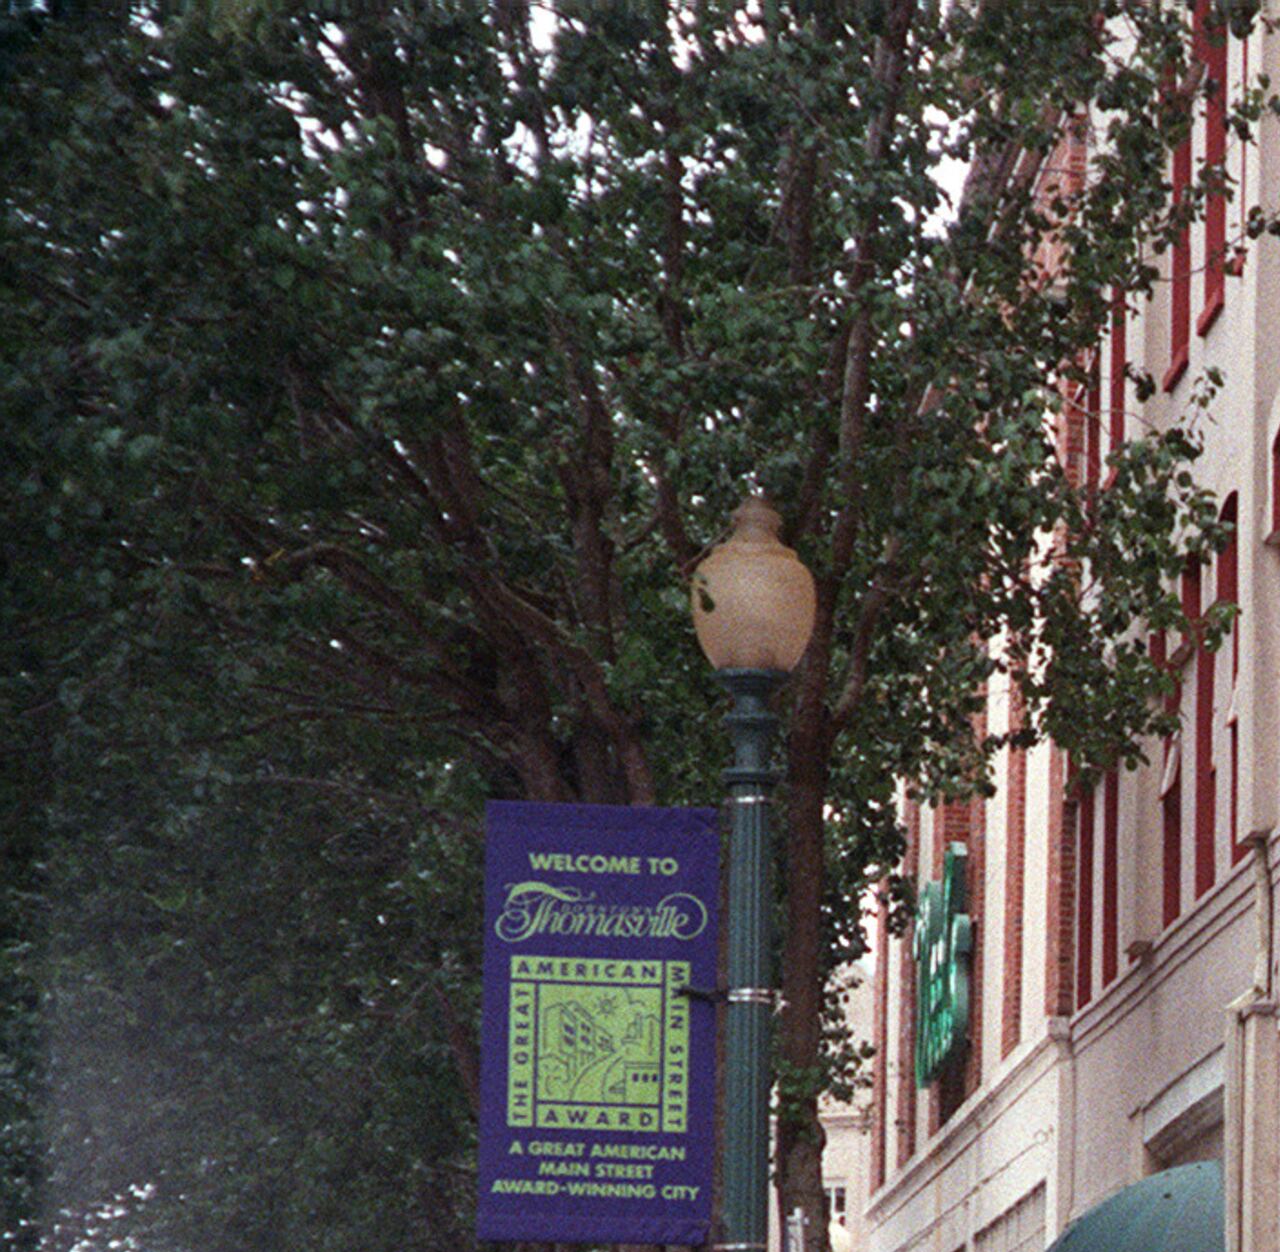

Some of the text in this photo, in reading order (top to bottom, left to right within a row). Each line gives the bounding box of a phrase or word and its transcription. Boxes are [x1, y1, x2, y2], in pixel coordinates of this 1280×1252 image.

[528, 853, 679, 876] WELCOME TO
[494, 881, 709, 943] Thomasville
[516, 960, 657, 979] AMERICAN
[513, 988, 530, 1121] THE GREAT
[667, 1045, 683, 1128] STREET
[544, 1110, 654, 1128] AWARD
[508, 1140, 687, 1161] A GREAT AMERICAN
[537, 1161, 655, 1179] MAIN STREET
[490, 1178, 700, 1201] AWARD-WINNING CITY
